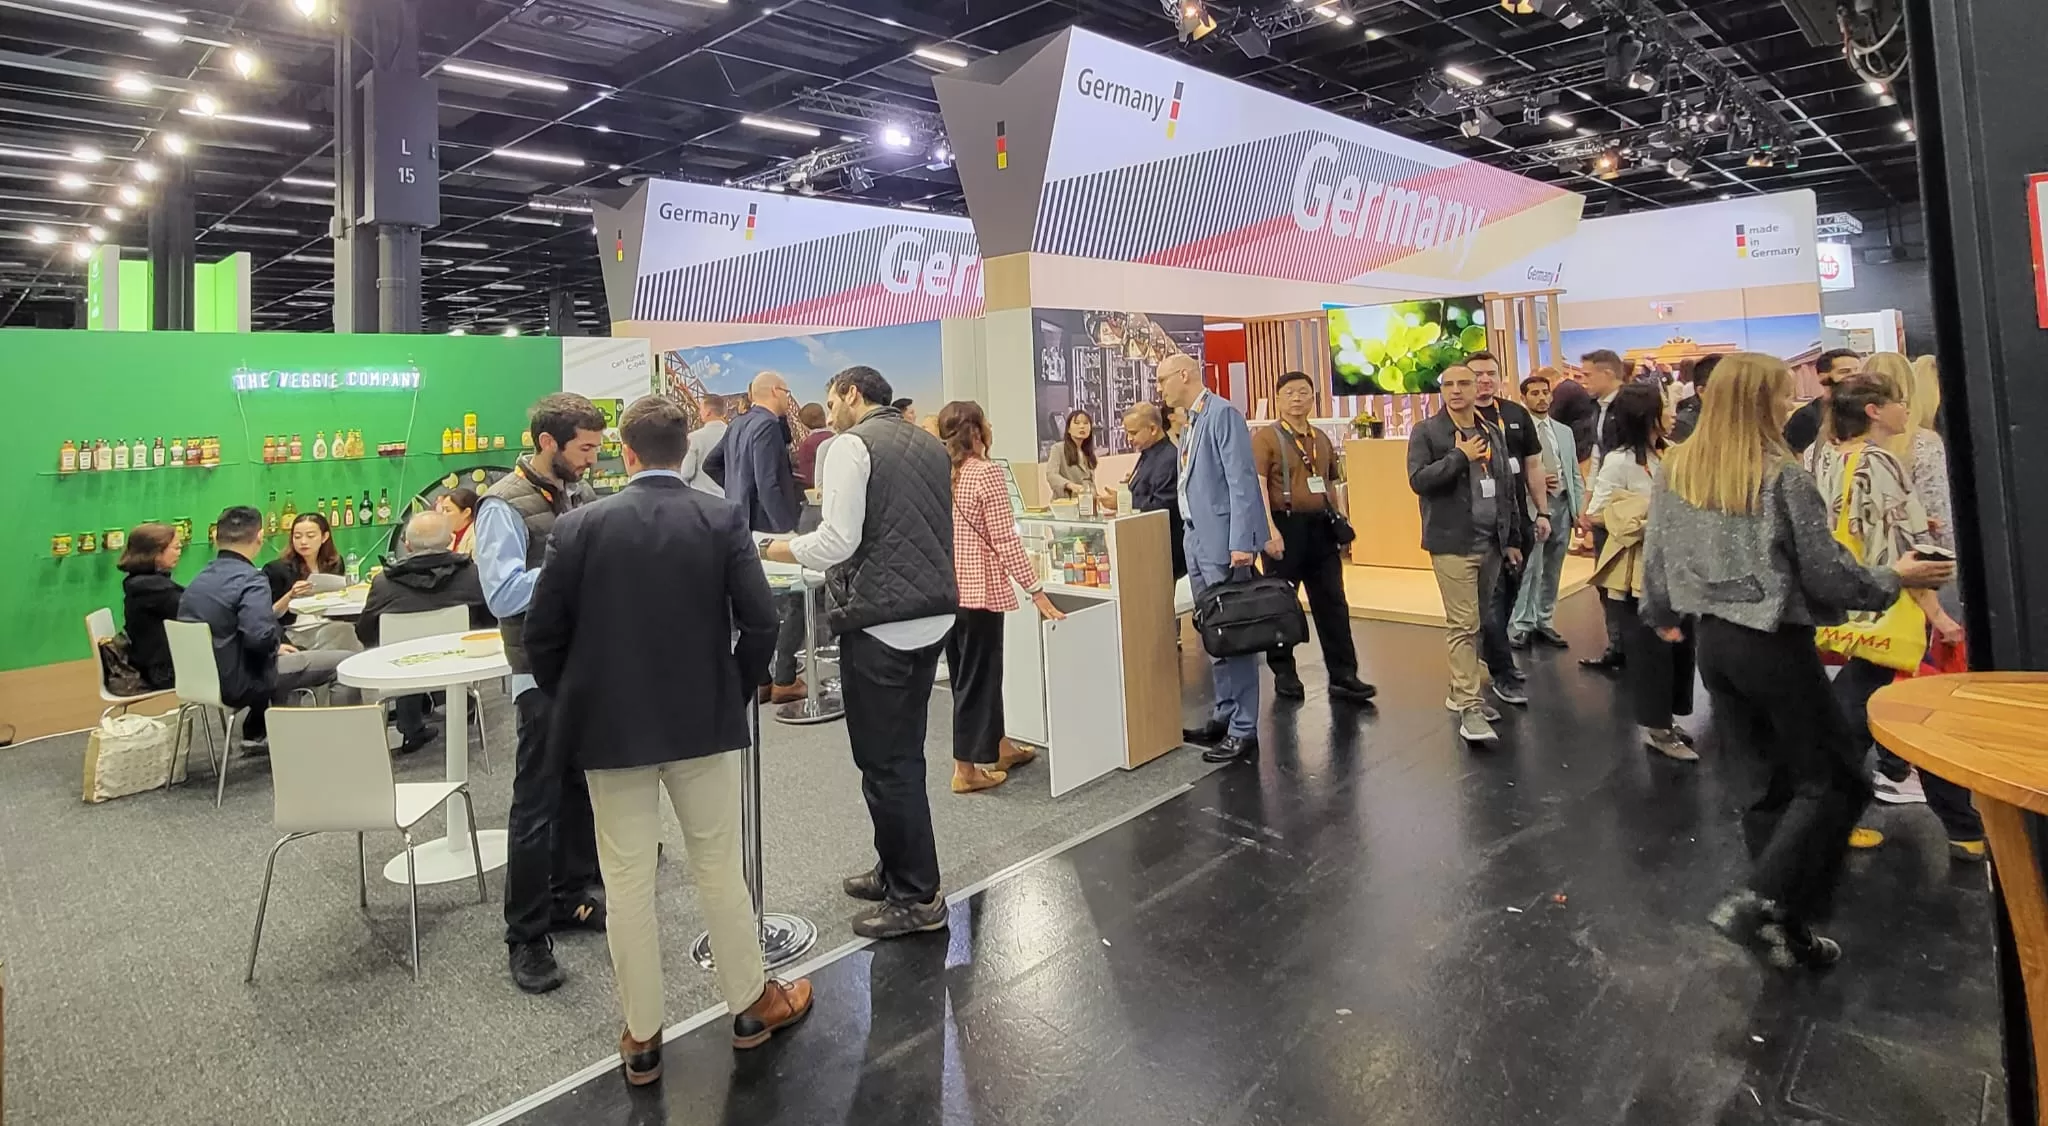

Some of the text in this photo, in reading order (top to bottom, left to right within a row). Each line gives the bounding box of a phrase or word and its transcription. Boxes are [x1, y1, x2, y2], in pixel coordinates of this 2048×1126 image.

[1077, 68, 1165, 122] Germany
[401, 138, 412, 155] L
[398, 167, 416, 184] 15
[659, 202, 741, 231] Germany
[1293, 140, 1486, 276] Germany
[1749, 224, 1779, 234] made
[1750, 239, 1760, 247] in
[1751, 246, 1801, 258] Germany
[880, 229, 985, 297] Ger
[1527, 265, 1554, 287] Germany
[235, 371, 421, 390] THE VEGGIE COMPANY
[1822, 627, 1891, 650] MAMA
